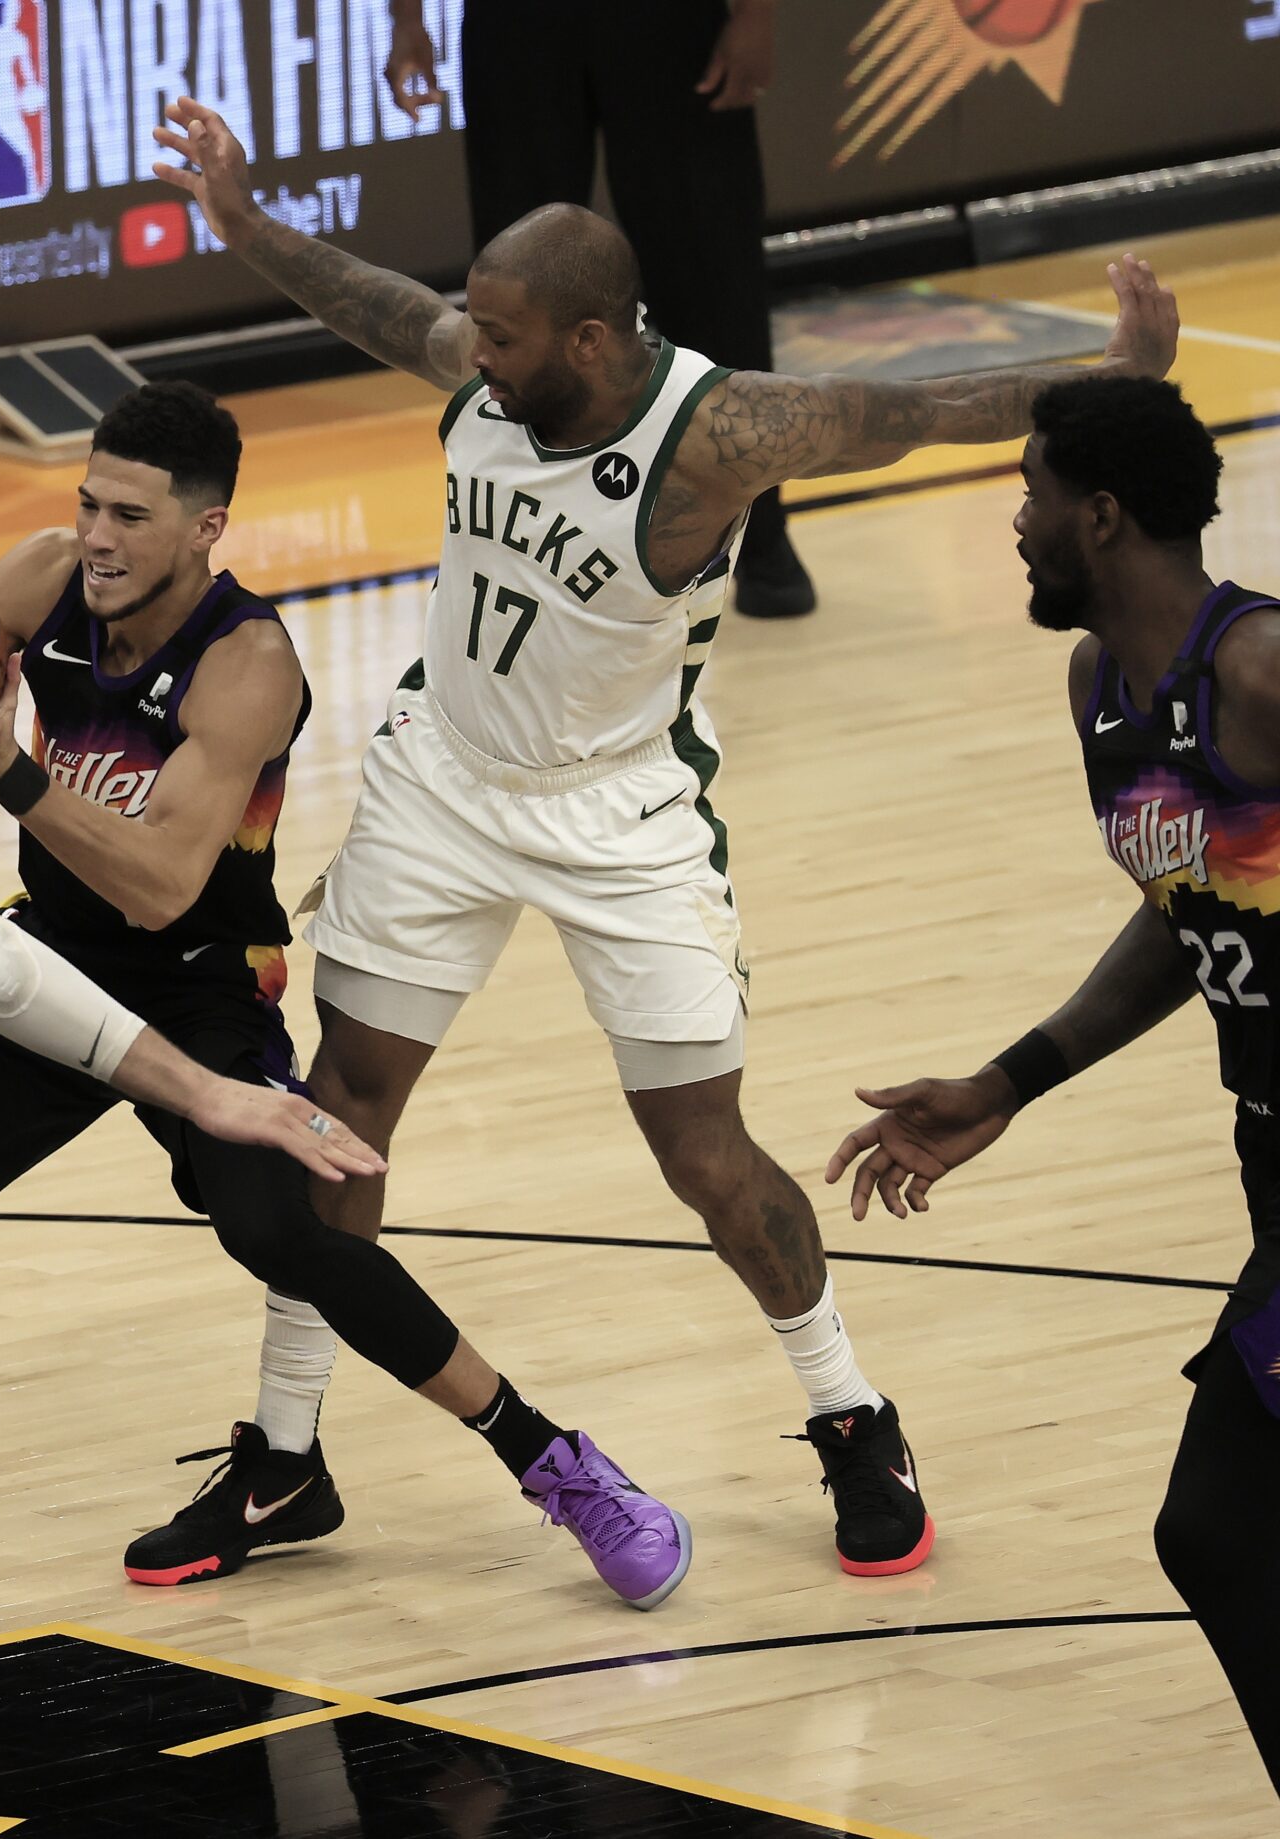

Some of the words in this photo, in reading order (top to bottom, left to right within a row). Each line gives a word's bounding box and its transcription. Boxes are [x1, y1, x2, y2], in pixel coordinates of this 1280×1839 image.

[60, 0, 257, 193] NBA
[270, 0, 467, 159] FINA
[446, 472, 621, 604] BUCKS
[466, 571, 540, 678] 17
[137, 699, 167, 720] PayPal
[1170, 735, 1197, 752] PayPal
[55, 749, 83, 766] THE
[1098, 798, 1210, 885] Valley
[1120, 815, 1138, 837] THE
[1179, 929, 1270, 1007] 22
